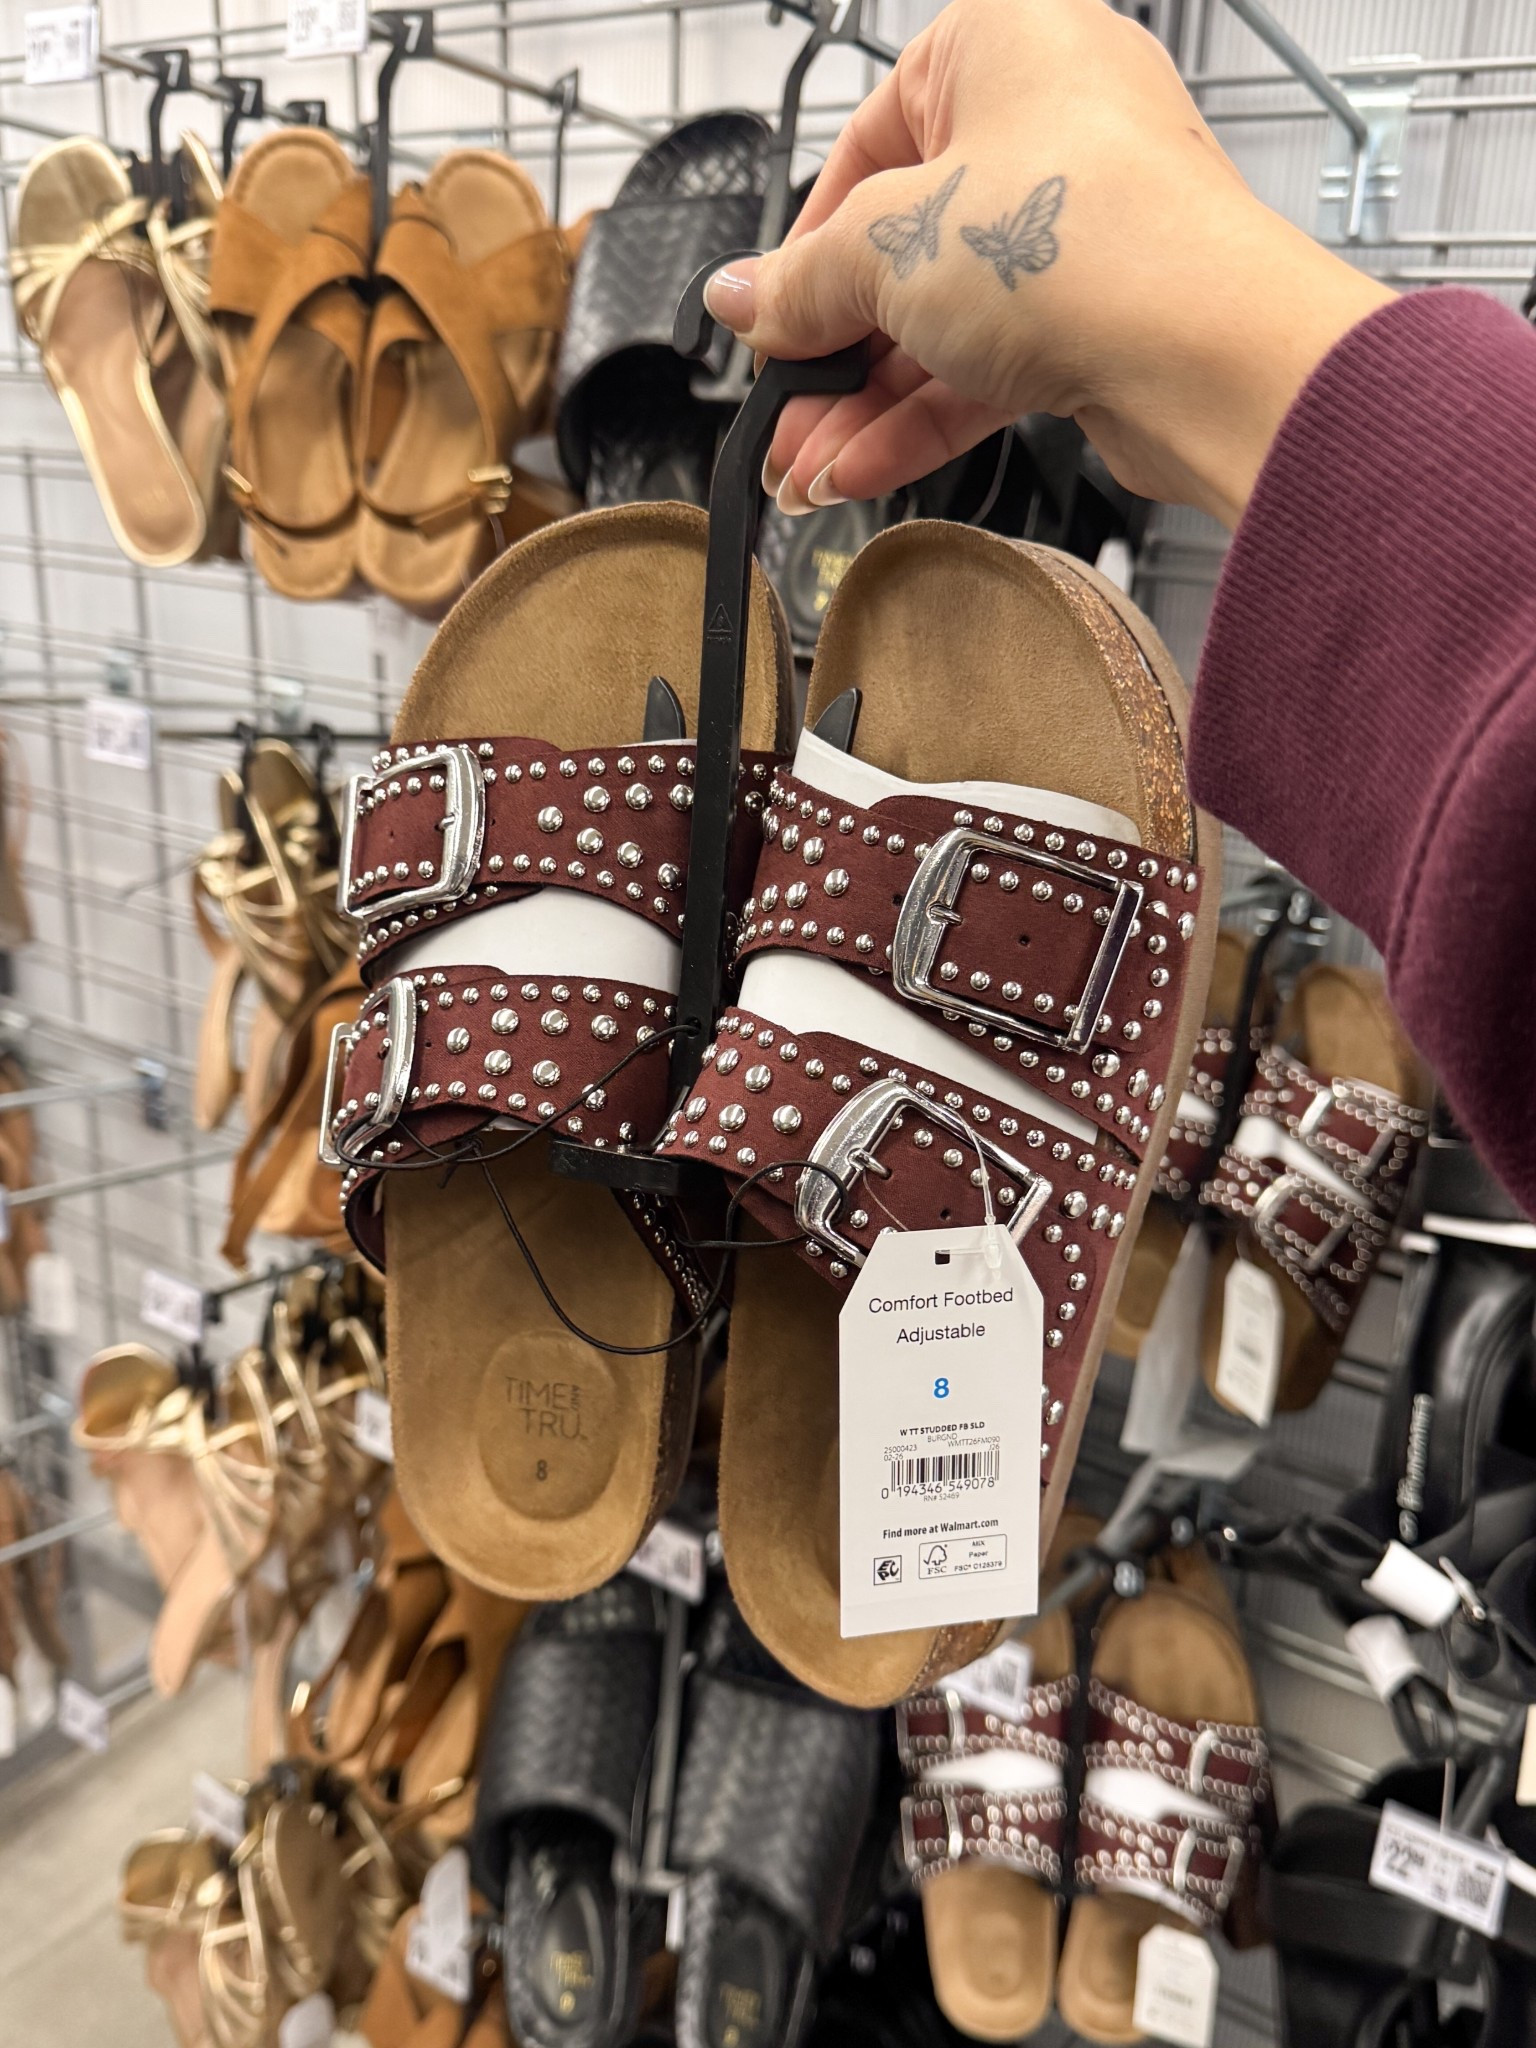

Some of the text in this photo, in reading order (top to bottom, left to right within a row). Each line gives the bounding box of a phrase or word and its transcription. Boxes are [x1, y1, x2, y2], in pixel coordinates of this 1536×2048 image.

[403, 16, 423, 53] 7
[165, 52, 181, 87] 7
[240, 81, 257, 114] 7
[868, 1287, 1013, 1313] Comfort Footbed
[896, 1322, 985, 1345] Adjustable
[505, 1376, 570, 1410] TIME
[934, 1377, 950, 1399] 8
[900, 1421, 985, 1437] W TT STUDDED FB SLD
[927, 1432, 958, 1443] BURGND
[884, 1444, 917, 1455] 25000423
[536, 1460, 548, 1481] 8
[881, 1476, 995, 1500] 0 194346 549078
[924, 1495, 937, 1503] RN#
[883, 1519, 999, 1539] Find more at Walmart.com
[927, 1566, 947, 1575] FSC
